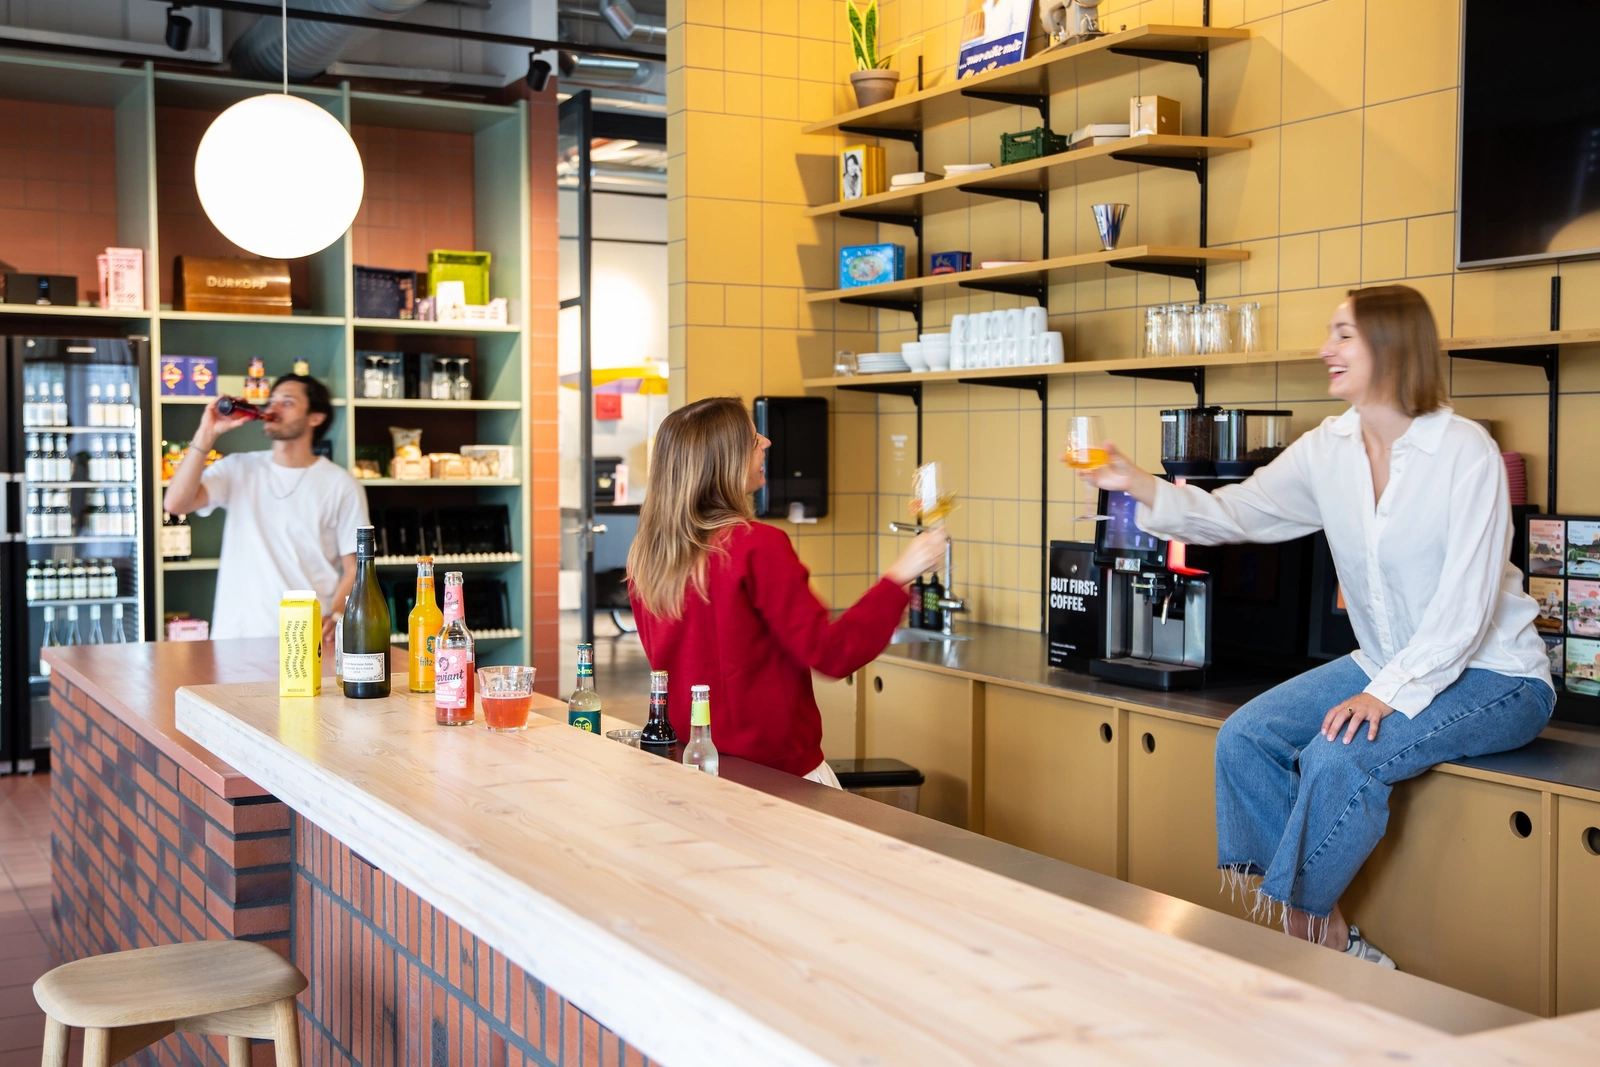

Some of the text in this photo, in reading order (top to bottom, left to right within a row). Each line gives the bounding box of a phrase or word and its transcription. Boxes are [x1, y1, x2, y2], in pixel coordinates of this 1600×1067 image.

[1050, 577, 1098, 596] BUT FIRST:
[1050, 593, 1086, 612] COFFEE.
[436, 669, 464, 682] oviant
